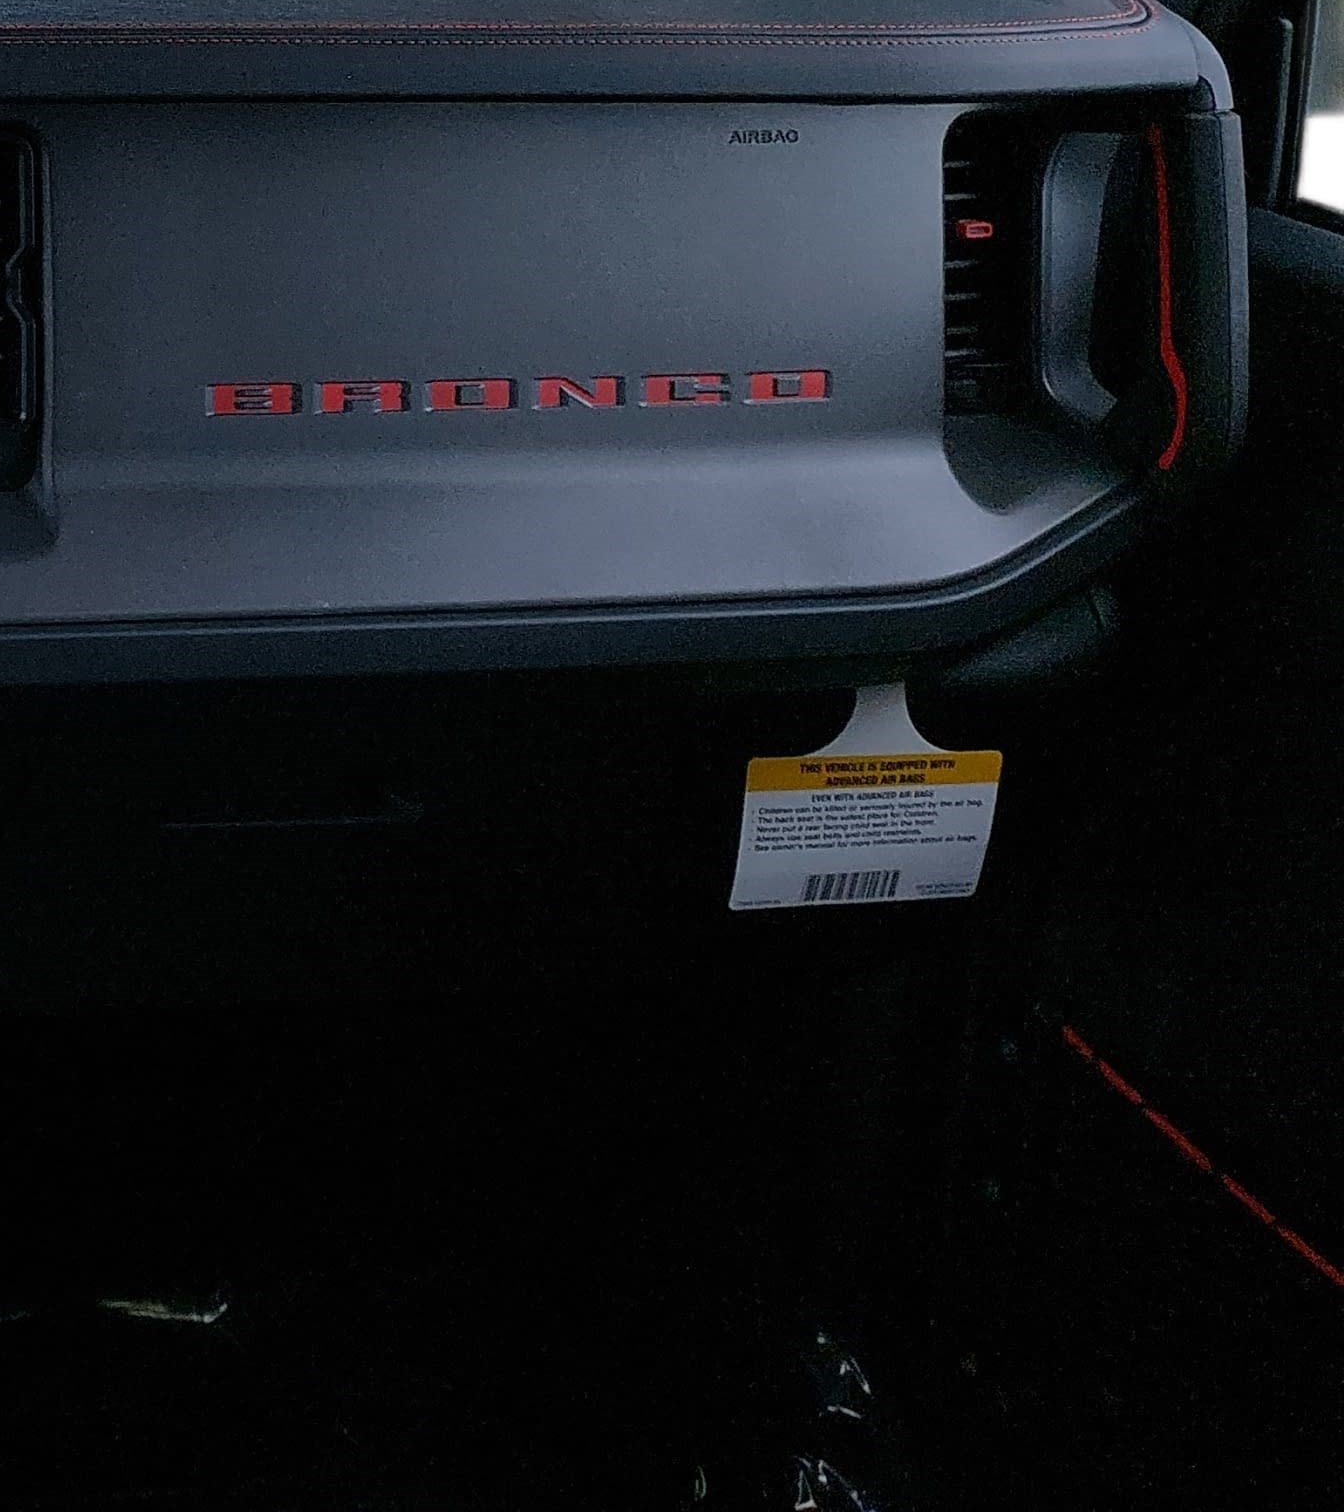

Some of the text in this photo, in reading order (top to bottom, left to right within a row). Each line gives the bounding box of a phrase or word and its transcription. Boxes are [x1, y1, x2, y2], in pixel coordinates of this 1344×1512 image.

[728, 129, 799, 144] AIRBAG
[206, 369, 834, 416] BRONCO
[800, 759, 956, 774] THIS VEHICLE IS EQUIPPED WITH
[824, 773, 927, 786] ADVANCED AIR BAGS
[834, 792, 855, 802] WITH
